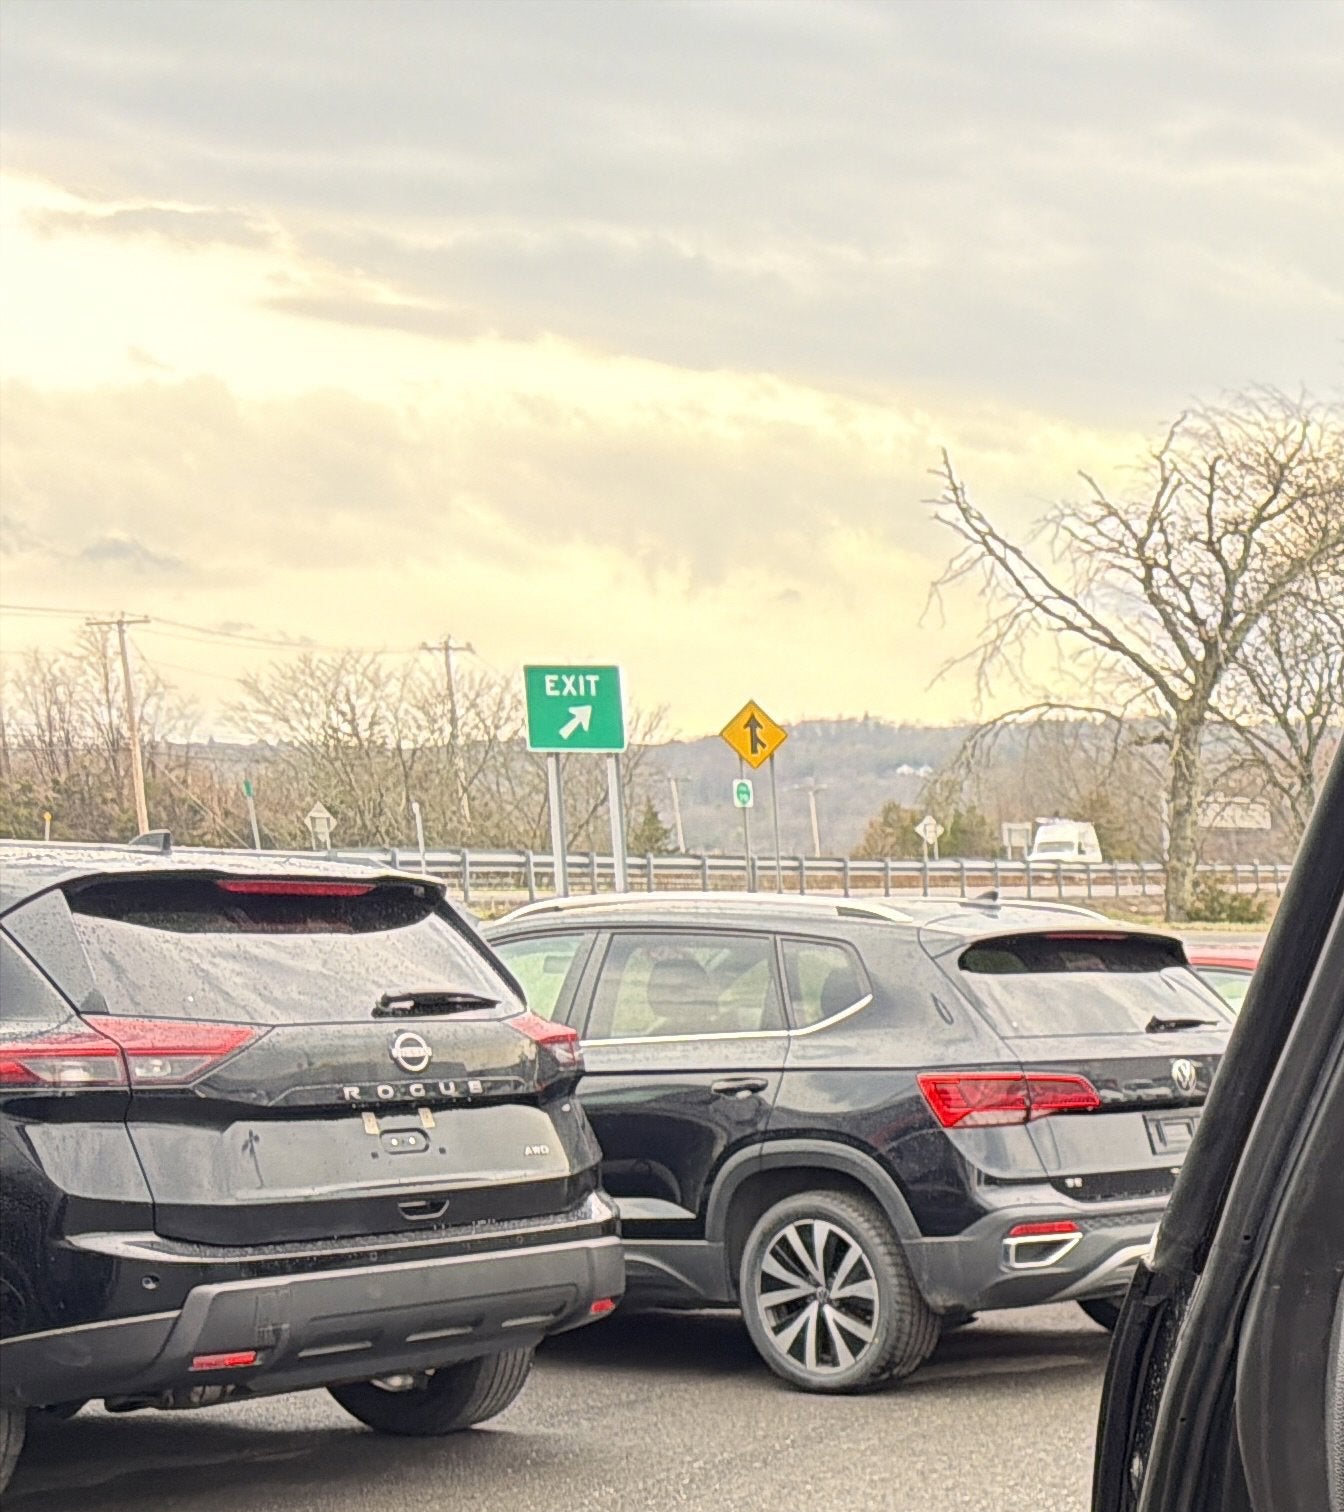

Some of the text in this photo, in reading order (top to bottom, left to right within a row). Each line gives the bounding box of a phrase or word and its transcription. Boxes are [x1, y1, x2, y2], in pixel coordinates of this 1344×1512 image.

[544, 674, 600, 697] EXIT
[343, 1080, 483, 1101] ROGUE
[524, 1143, 550, 1156] AWD
